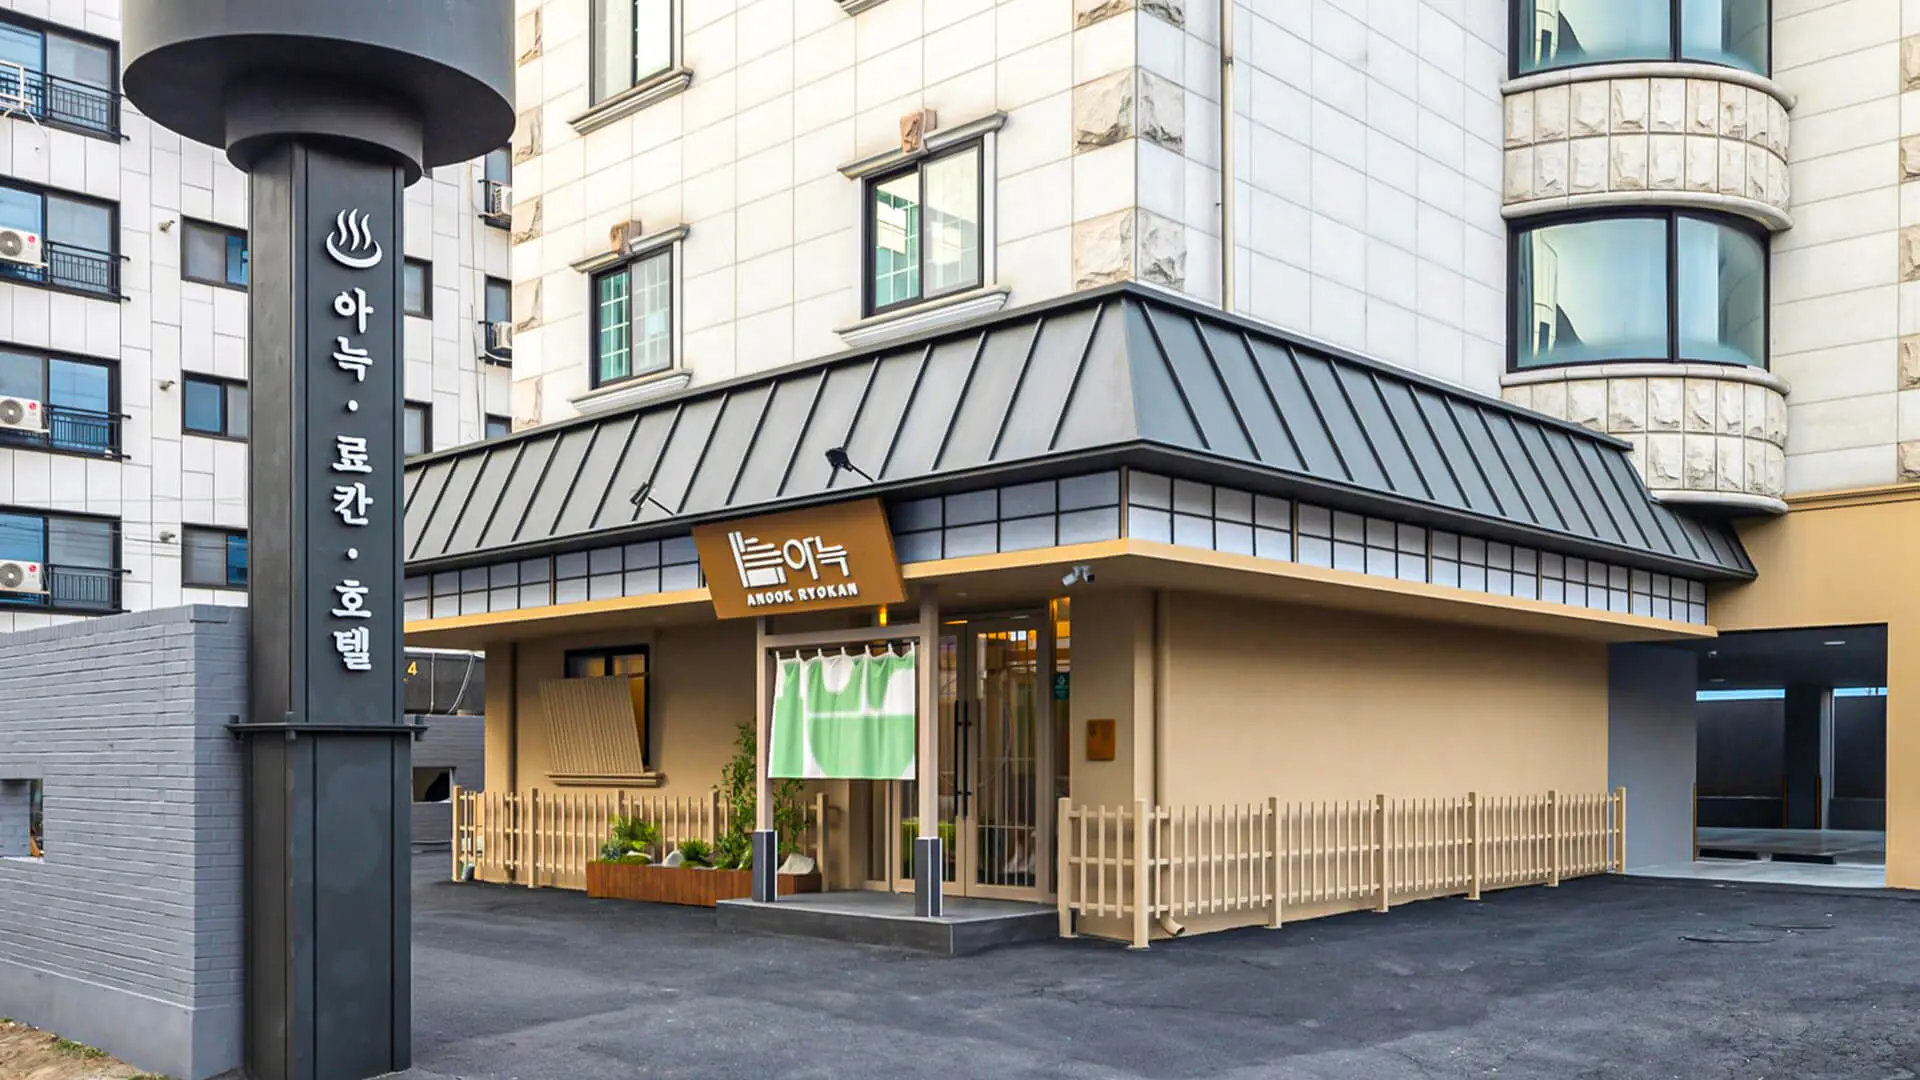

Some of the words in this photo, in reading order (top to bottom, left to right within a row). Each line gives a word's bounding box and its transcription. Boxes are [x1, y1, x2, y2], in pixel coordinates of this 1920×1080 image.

[747, 588, 795, 606] ANOOK
[797, 582, 858, 601] RYOKAN
[331, 579, 373, 670] 호텔
